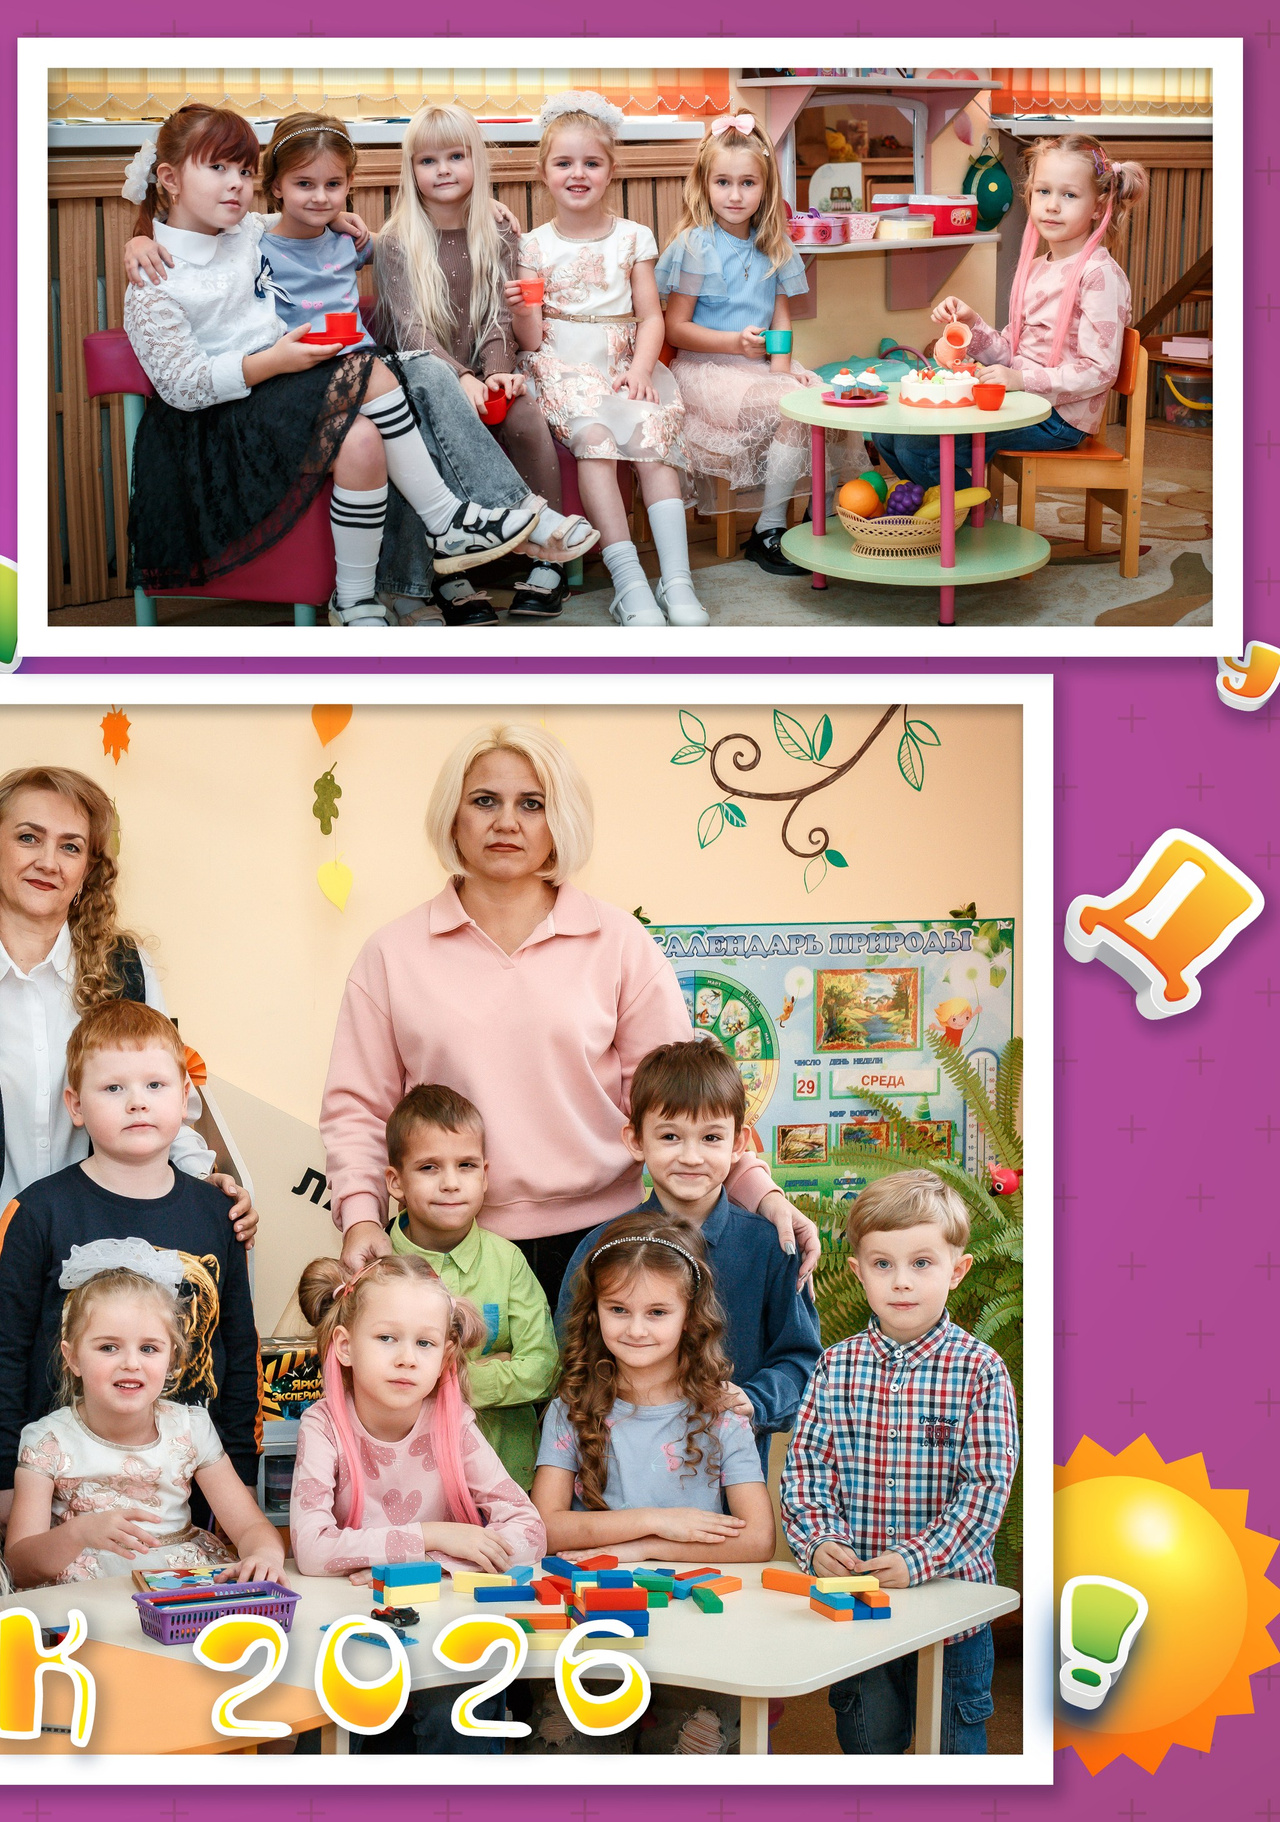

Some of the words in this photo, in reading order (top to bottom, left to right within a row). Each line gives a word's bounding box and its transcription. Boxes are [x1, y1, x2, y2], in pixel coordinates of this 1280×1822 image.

[829, 929, 973, 956] ПРИРОДЫ
[744, 989, 761, 1009] ВЕСНА
[794, 1059, 821, 1067] ЧИСЛО
[796, 1079, 816, 1095] 29
[861, 1075, 905, 1089] СРЕДА
[919, 1415, 959, 1427] Original
[925, 1425, 950, 1440] R50
